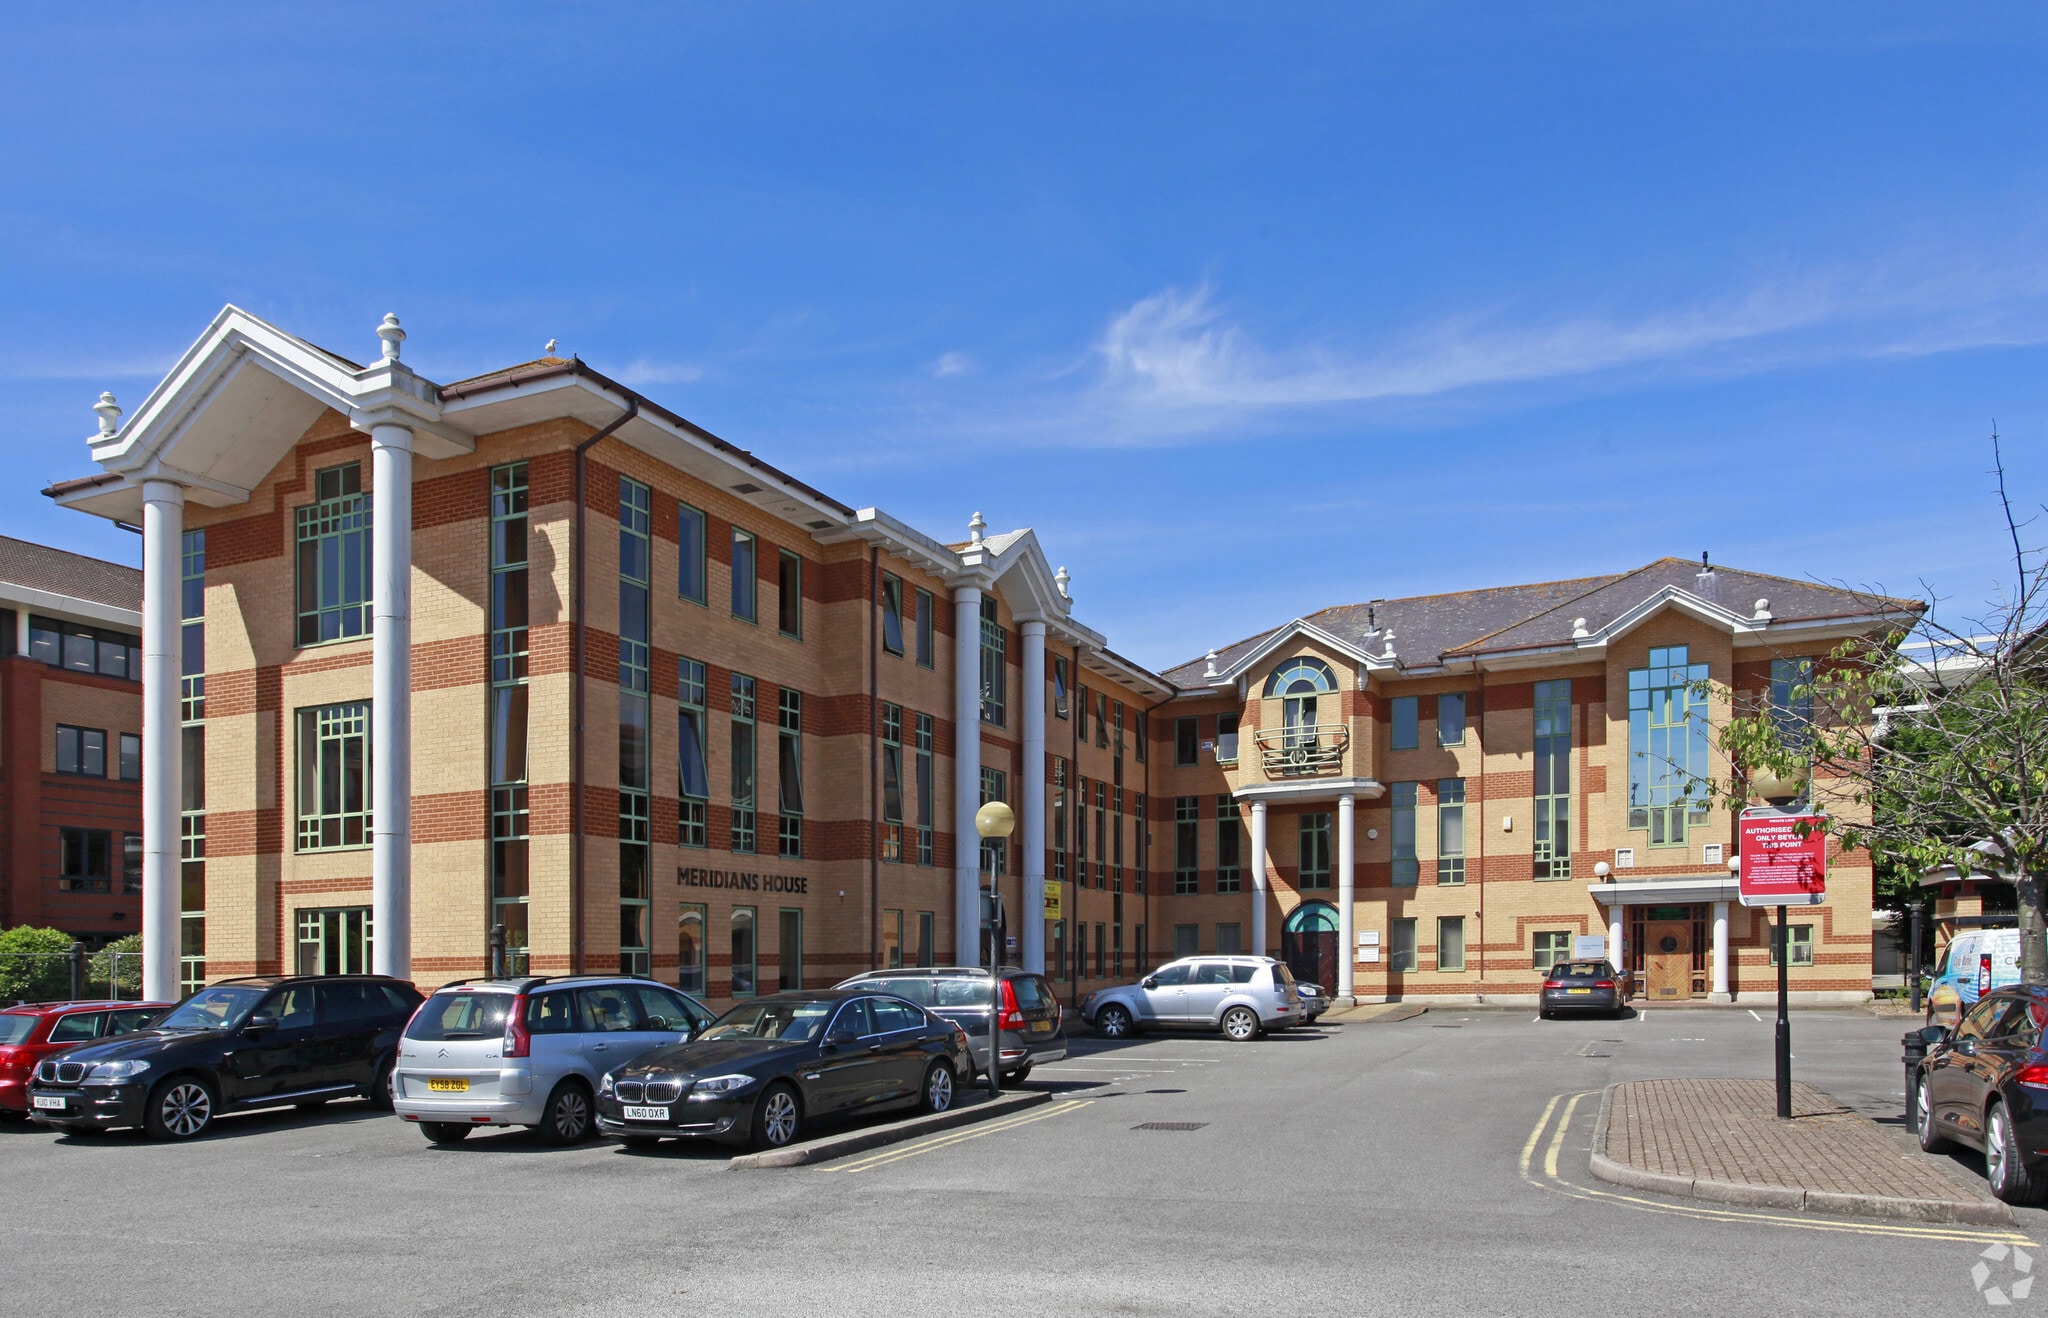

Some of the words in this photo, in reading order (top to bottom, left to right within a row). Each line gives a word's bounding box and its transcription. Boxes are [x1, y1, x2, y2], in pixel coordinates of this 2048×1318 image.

[1745, 826, 1793, 835] AUTHORISED
[1756, 834, 1776, 842] ONLY
[1777, 833, 1804, 841] BEYON
[1762, 841, 1779, 849] THIS
[1780, 840, 1803, 848] POINT
[677, 866, 759, 891] MERIDIANS
[763, 874, 807, 894] HOUSE
[431, 1079, 449, 1089] EY58
[451, 1080, 466, 1090] ZGL
[49, 1098, 61, 1106] VHA
[627, 1107, 647, 1118] LN60
[648, 1108, 666, 1118] OXR
